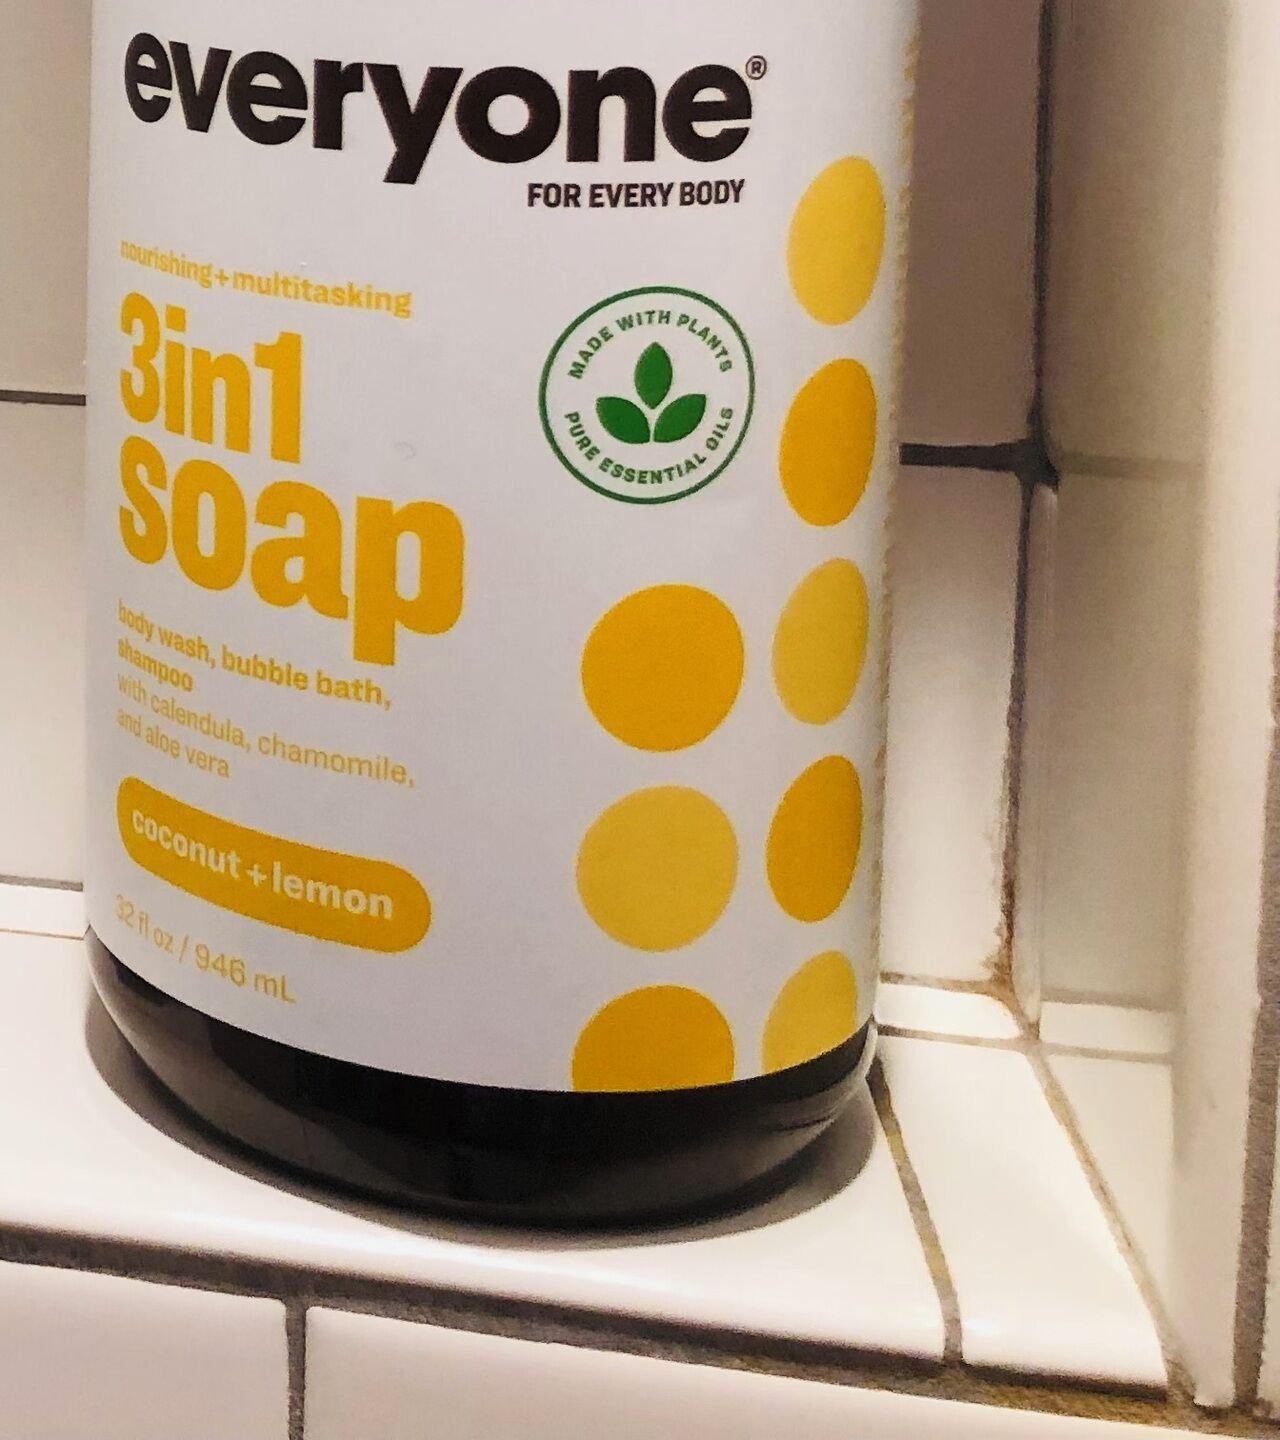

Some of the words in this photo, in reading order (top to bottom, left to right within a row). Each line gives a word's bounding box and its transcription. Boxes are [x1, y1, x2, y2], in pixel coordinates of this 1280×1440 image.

[527, 183, 581, 208] FOR
[589, 183, 674, 208] EVERY
[679, 179, 746, 206] BODY
[120, 291, 302, 464] 3in1
[567, 326, 614, 379] MADE
[615, 310, 671, 331] WITH
[676, 313, 733, 372] PLANTS
[564, 411, 601, 461] PURE
[598, 453, 707, 485] ESSENTIAL
[705, 407, 733, 451] OILS
[119, 435, 466, 666] soap
[117, 637, 194, 693] shampoo
[118, 599, 154, 643] body
[158, 627, 216, 669] wash,
[221, 644, 309, 692] bubble
[316, 670, 392, 711] bath,
[117, 672, 147, 706] with
[151, 696, 251, 753] calendula,
[258, 732, 417, 789] chamomile,
[117, 709, 141, 738] and
[146, 725, 181, 760] aloe
[185, 747, 230, 779] vera
[132, 809, 242, 880] coconut
[272, 861, 394, 920] lemon
[116, 894, 134, 929] 32
[154, 927, 175, 954] oz
[195, 943, 247, 988] 946
[254, 973, 297, 1005] mL
